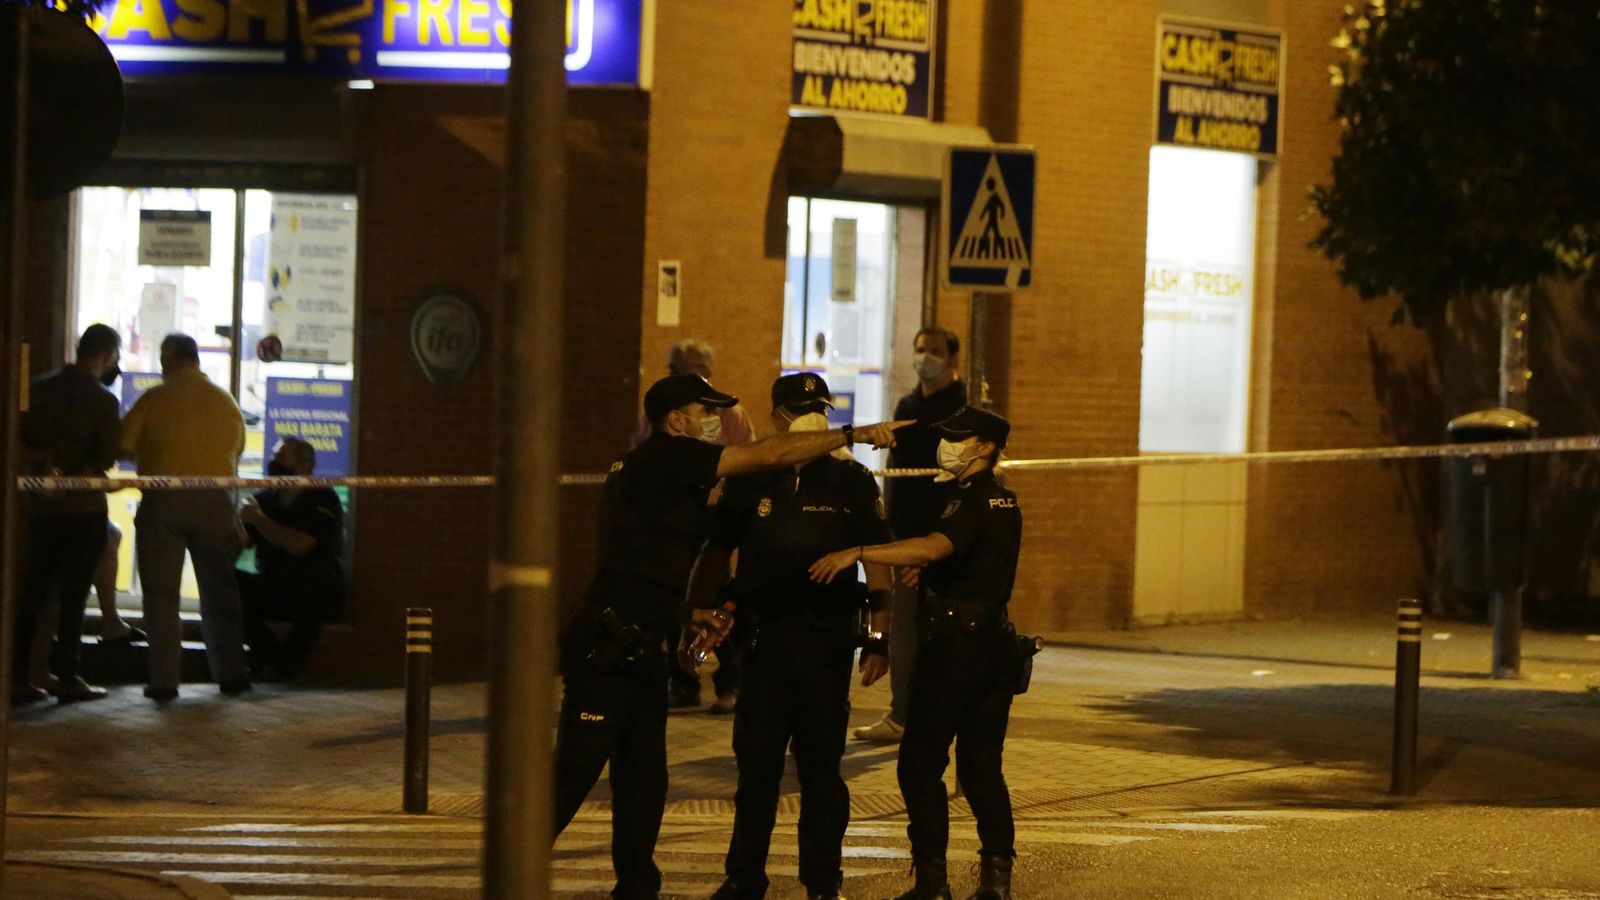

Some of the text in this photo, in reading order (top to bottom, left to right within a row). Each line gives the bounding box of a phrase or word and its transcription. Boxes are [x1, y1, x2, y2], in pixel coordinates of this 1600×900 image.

[84, 0, 288, 43] ASH
[793, 41, 916, 85] BIENVENIDOS
[1163, 34, 1278, 85] CASH FRESH
[801, 75, 908, 115] AL AHORRO
[1167, 85, 1268, 125] BIENVENIDOS
[1173, 116, 1262, 151] AL AHORRO
[580, 711, 606, 722] CNP
